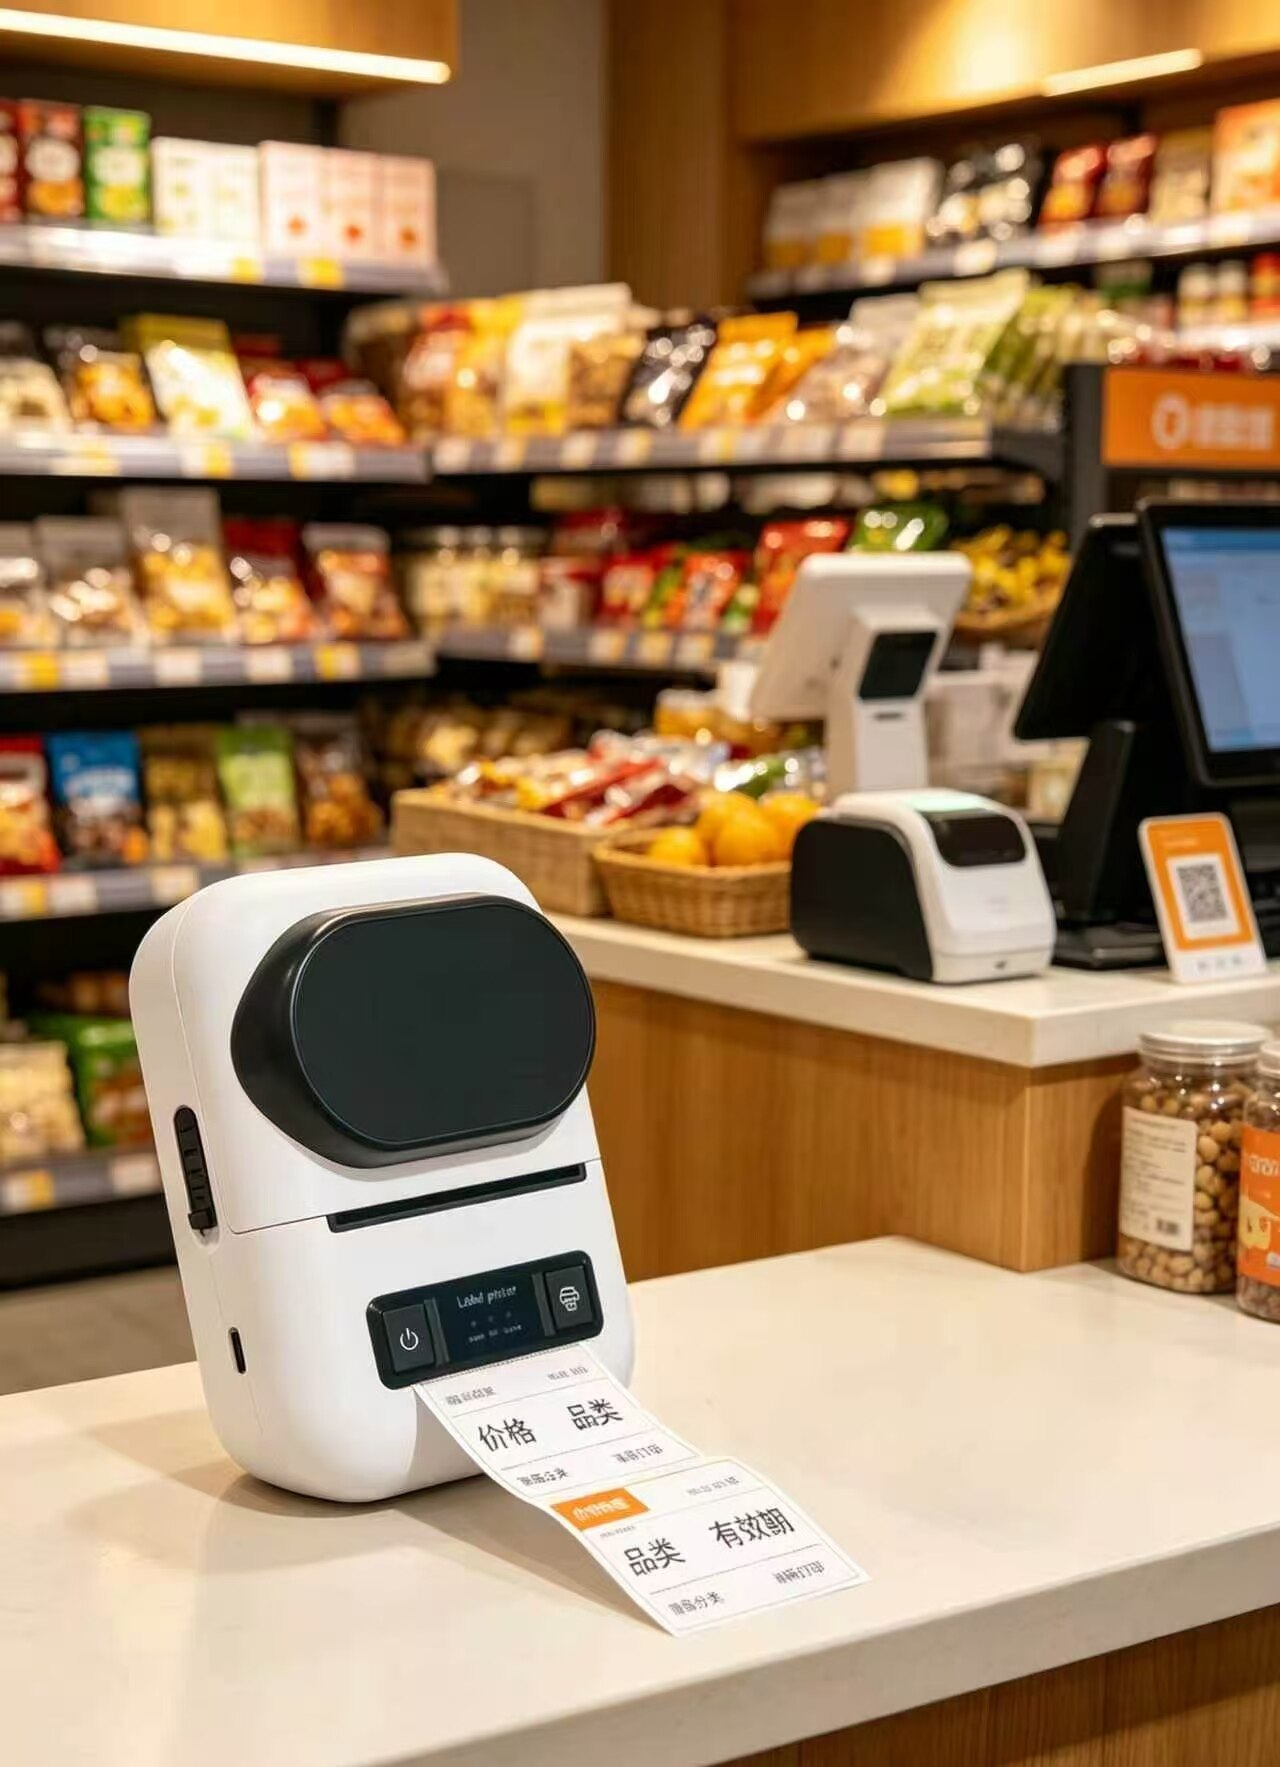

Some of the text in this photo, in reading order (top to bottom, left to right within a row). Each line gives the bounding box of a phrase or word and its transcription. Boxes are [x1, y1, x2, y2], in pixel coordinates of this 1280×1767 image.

[478, 1397, 624, 1453] 价格 品类
[623, 1537, 686, 1577] 品类
